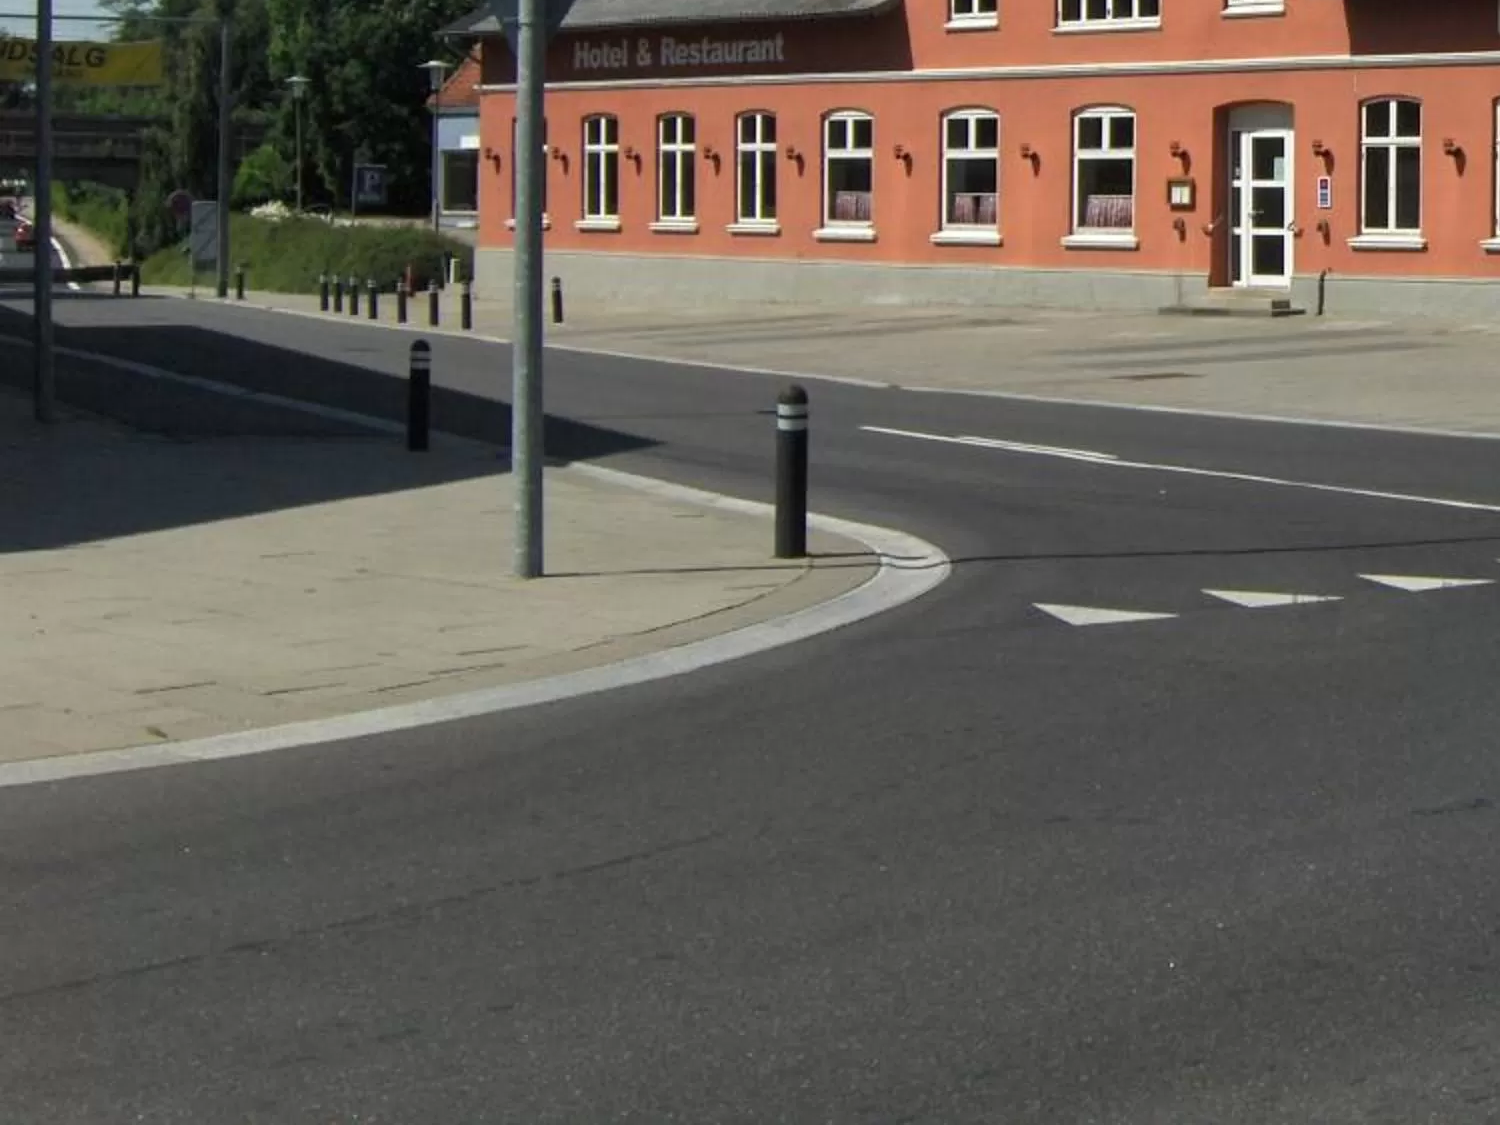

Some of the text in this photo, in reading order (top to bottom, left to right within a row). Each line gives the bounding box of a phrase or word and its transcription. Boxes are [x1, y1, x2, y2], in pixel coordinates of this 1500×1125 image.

[573, 31, 785, 70] Hotel & Restaurant
[363, 170, 380, 192] P
